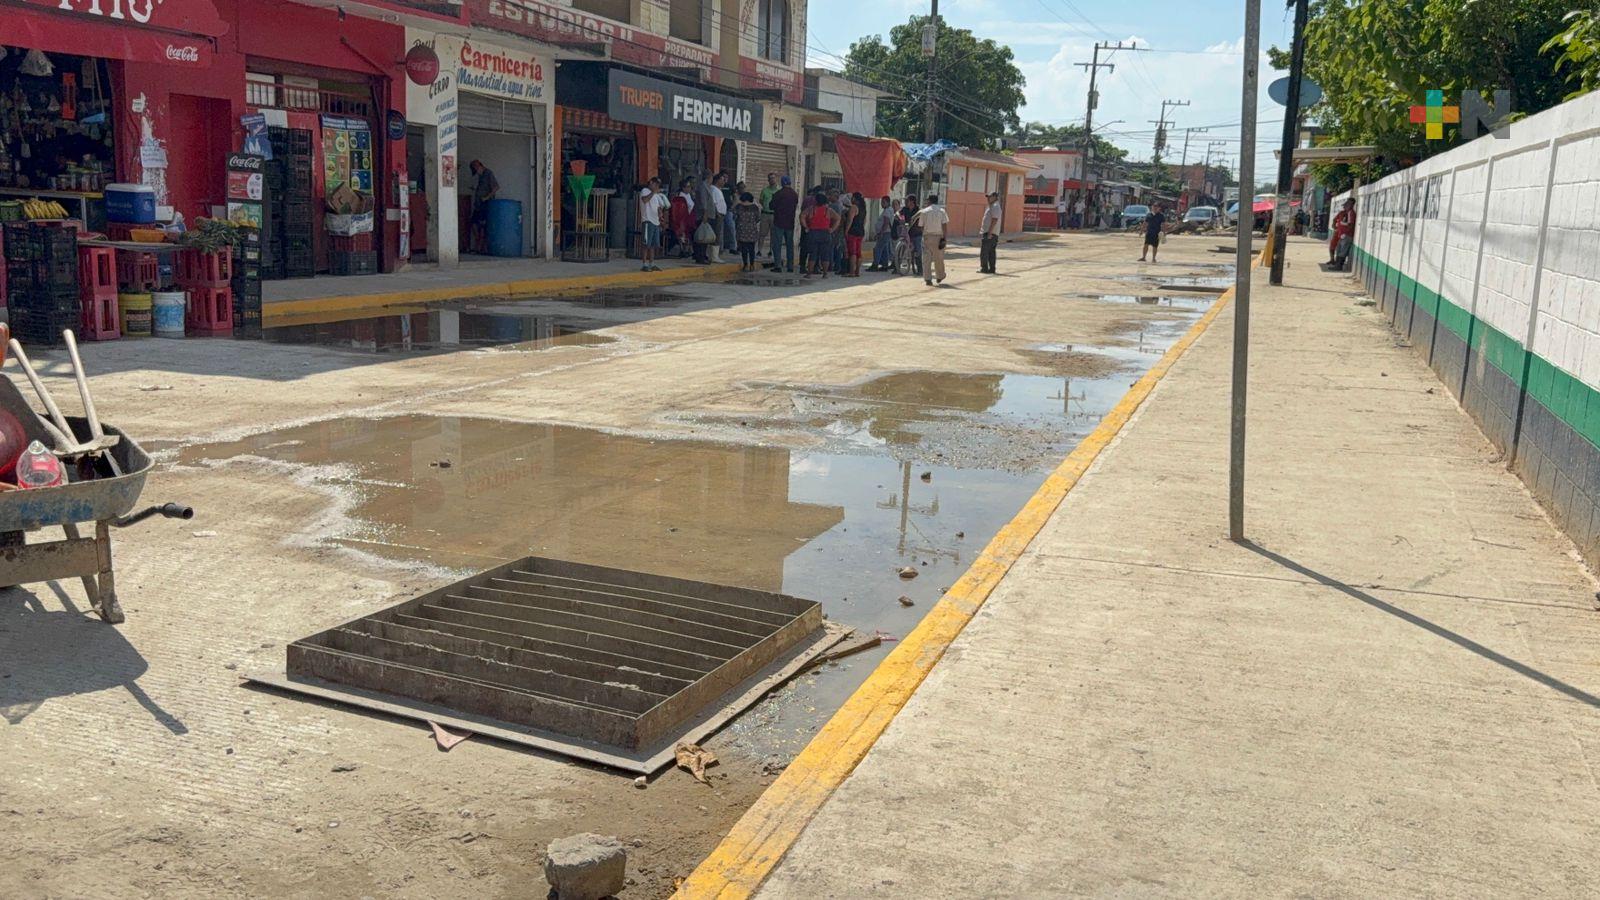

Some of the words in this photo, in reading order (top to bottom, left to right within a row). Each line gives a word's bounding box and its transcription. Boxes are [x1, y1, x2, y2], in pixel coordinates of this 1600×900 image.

[488, 0, 614, 43] ESTUDIOS
[460, 41, 542, 81] Carnicería
[619, 85, 664, 110] TRUPER
[673, 95, 752, 132] FERREMAR
[773, 117, 785, 133] FIT
[229, 155, 261, 169] Coca-Cola
